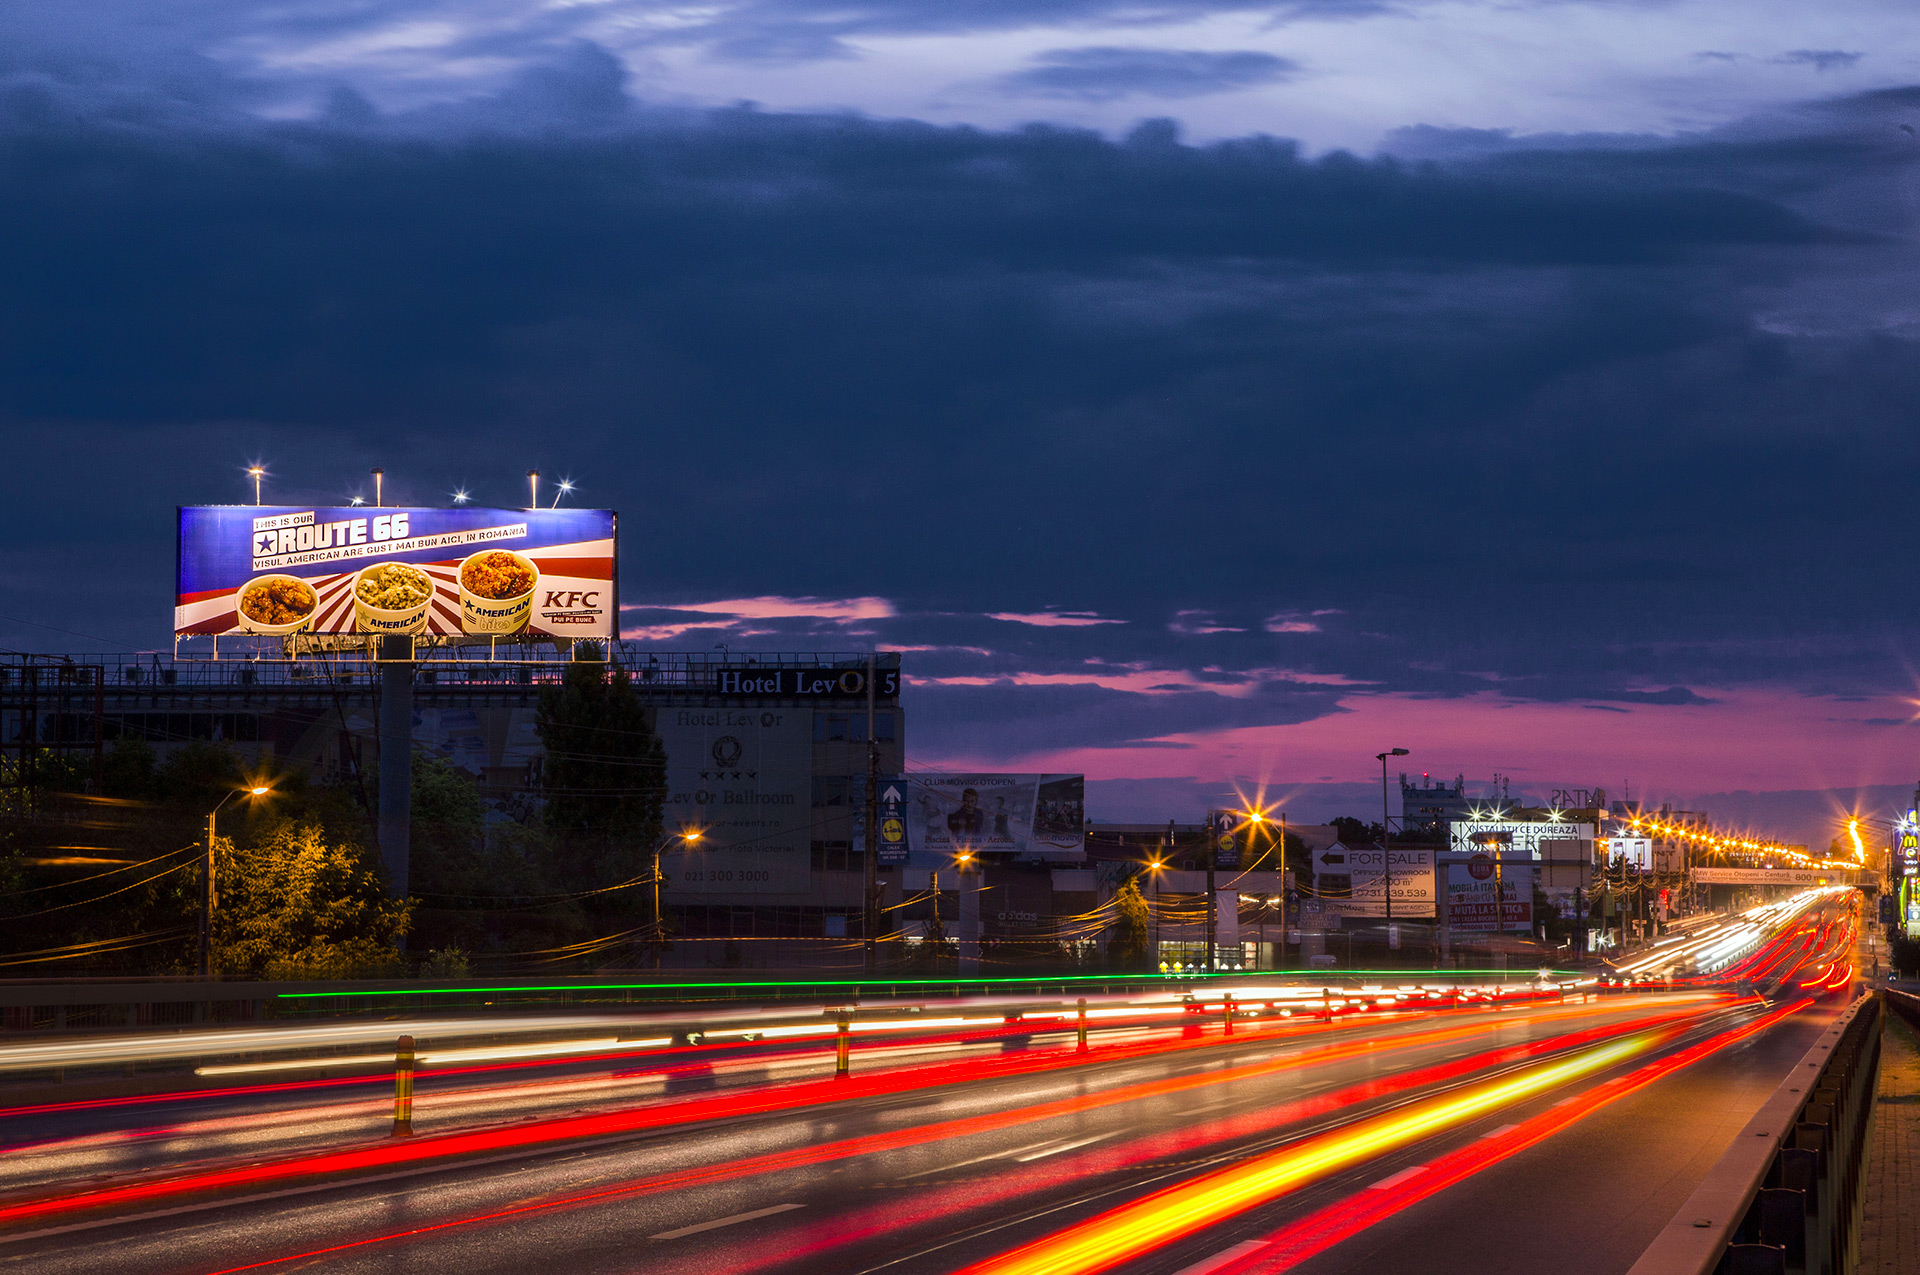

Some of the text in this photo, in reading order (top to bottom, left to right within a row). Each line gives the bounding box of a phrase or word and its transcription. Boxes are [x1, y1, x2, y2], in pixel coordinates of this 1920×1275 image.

[255, 514, 314, 530] THIS IS OUR
[278, 512, 409, 554] ROUTE 66
[254, 527, 526, 569] VISUL AMERICAN ARE GUST MAI BUN AICI, IN ROMANIA
[542, 591, 600, 608] KFC
[475, 598, 531, 618] AMERICAN
[369, 609, 426, 630] AMERICAN
[720, 671, 782, 694] Hotel
[884, 671, 897, 694] 5
[677, 711, 721, 727] Hotel
[726, 711, 757, 727] Lev
[924, 778, 1016, 787] CLUB MOVING OTOPENI
[722, 789, 795, 805] Ballroom
[1519, 825, 1532, 834] CE
[1533, 823, 1578, 834] DUREAZĂ
[1349, 853, 1428, 865] FOR SALE
[684, 870, 770, 882] 021 300 3000
[1733, 871, 1759, 879] Otopeni
[1795, 874, 1812, 882] 800
[1478, 904, 1489, 914] LA
